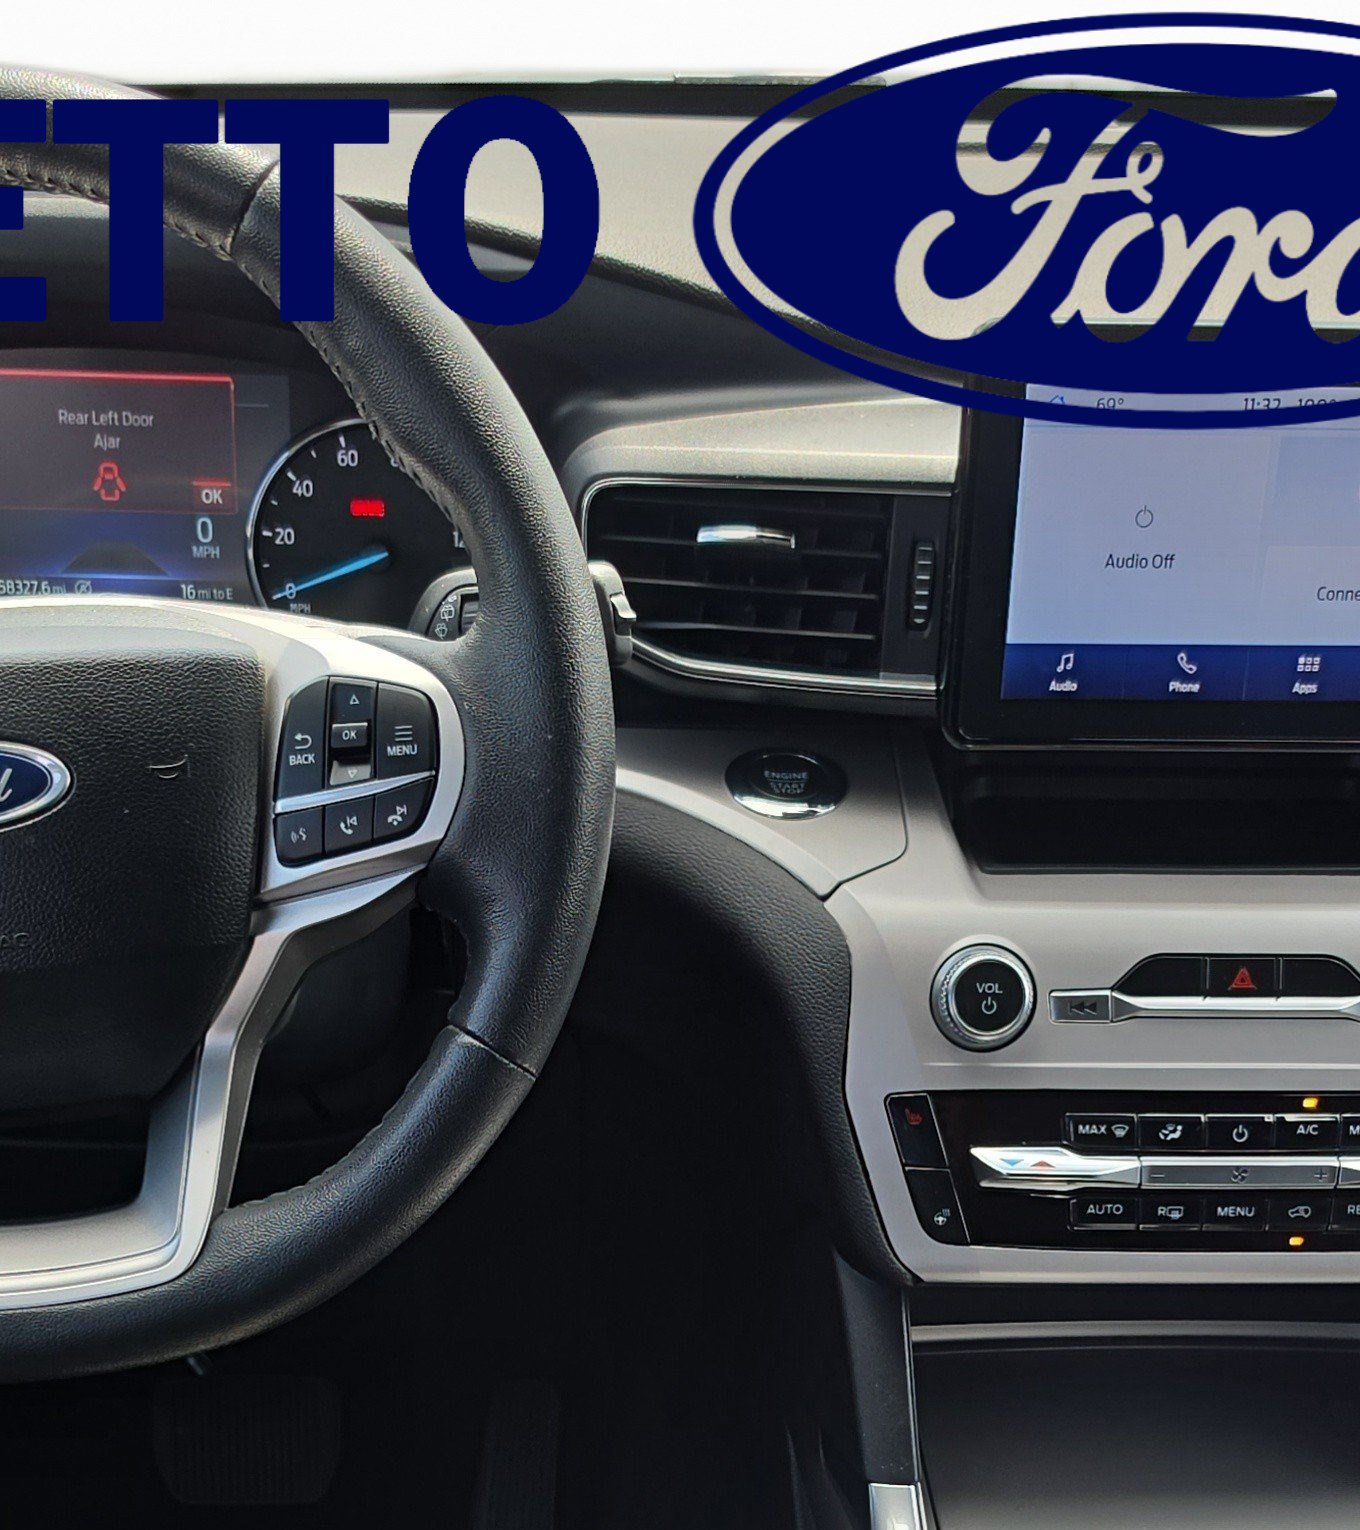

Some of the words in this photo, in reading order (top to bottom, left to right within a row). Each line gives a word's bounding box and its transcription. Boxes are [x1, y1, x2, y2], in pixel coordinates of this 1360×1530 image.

[57, 409, 89, 426] Rear
[92, 410, 120, 427] Left
[122, 411, 154, 428] Door
[93, 433, 121, 451] Ajar
[336, 450, 358, 467] 60
[292, 479, 314, 497] 40
[201, 489, 223, 504] OK
[196, 516, 213, 543] 0
[274, 527, 295, 545] 20
[192, 546, 220, 559] MPH
[1105, 552, 1148, 570] Audio
[1151, 553, 1175, 570] Off
[180, 583, 196, 599] 16
[1048, 681, 1078, 692] Audio
[1168, 681, 1200, 693] Phone
[1292, 681, 1318, 695] Apps
[342, 730, 357, 741] OK
[386, 743, 418, 757] MENU
[289, 753, 316, 766] BACK
[976, 982, 1003, 995] VOL
[1078, 1125, 1107, 1136] MAX
[1296, 1124, 1319, 1136] A/C
[1086, 1203, 1124, 1216] AUTO
[1217, 1206, 1255, 1218] MENU
